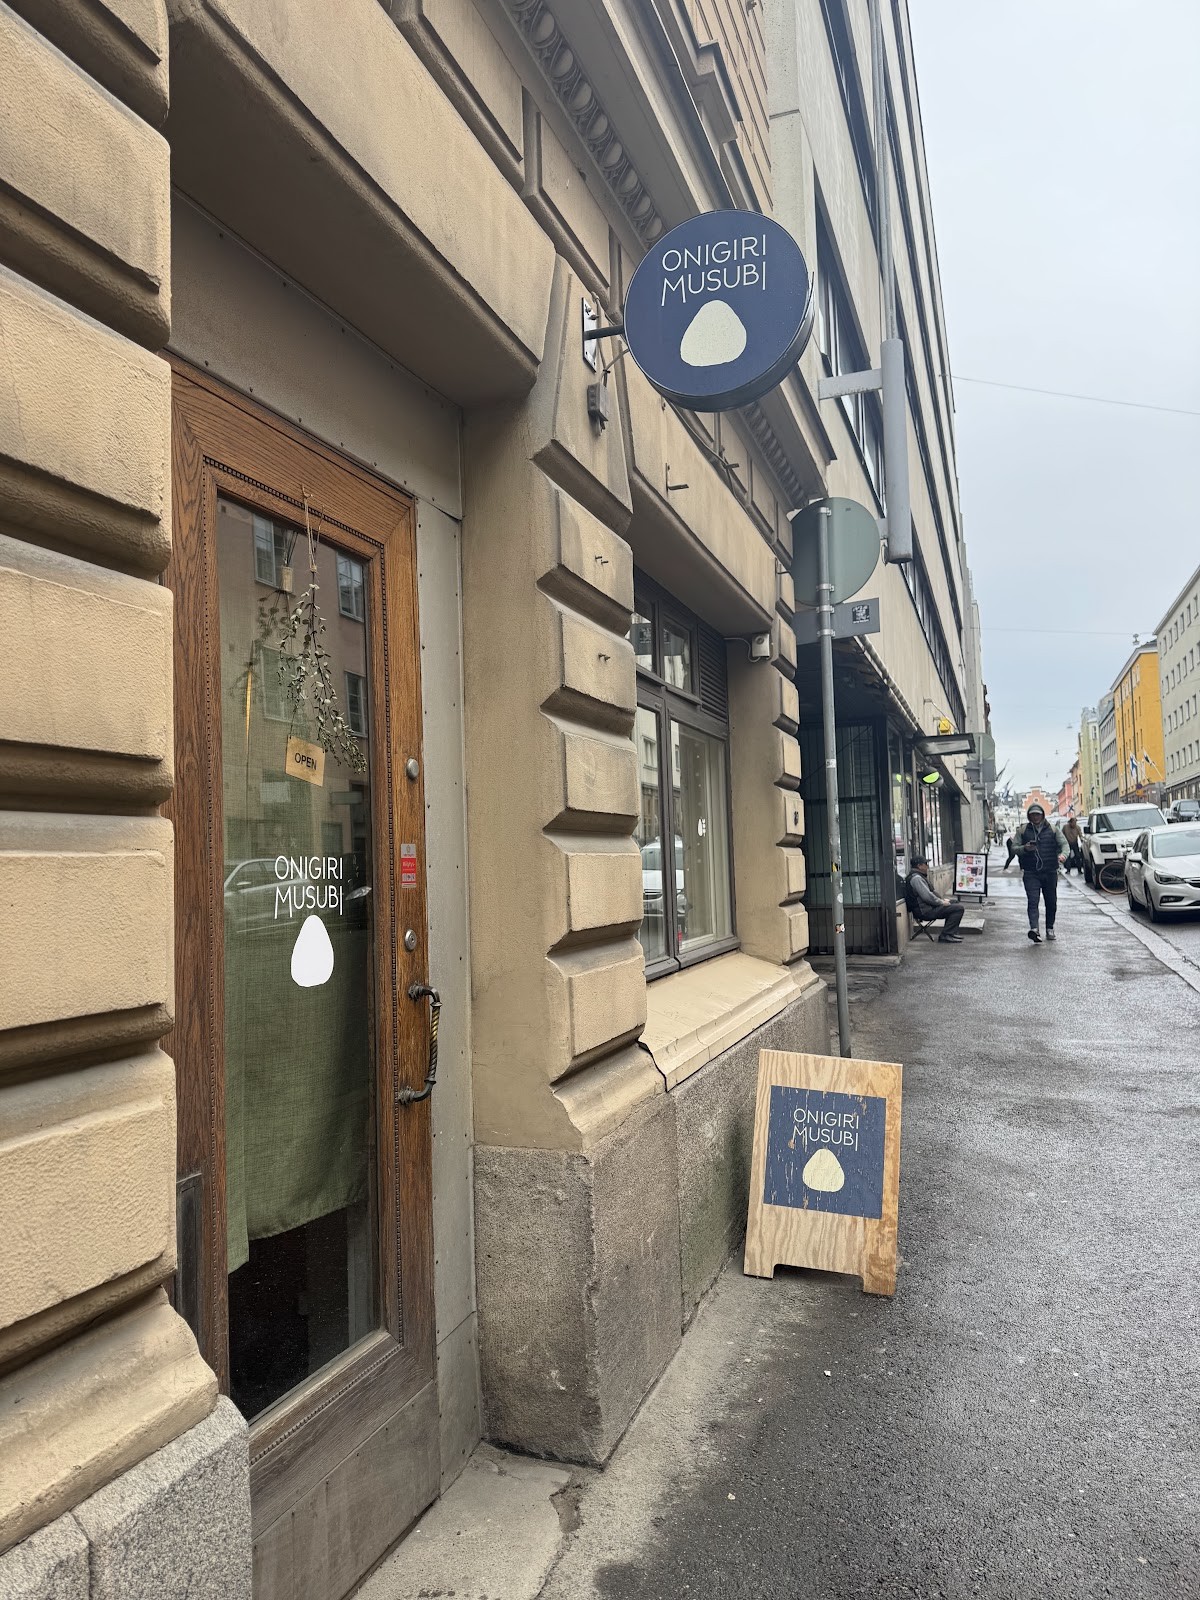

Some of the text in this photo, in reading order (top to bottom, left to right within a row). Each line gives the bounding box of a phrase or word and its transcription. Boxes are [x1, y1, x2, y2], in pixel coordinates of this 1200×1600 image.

[662, 234, 766, 272] ONIGIRI
[661, 261, 766, 306] MUSUBI
[294, 752, 317, 771] OPEN
[274, 855, 343, 880] ONIGIRI
[274, 885, 343, 919] MUSUBI
[793, 1108, 859, 1130] ONIGIRI
[792, 1125, 858, 1151] MUSUBI
